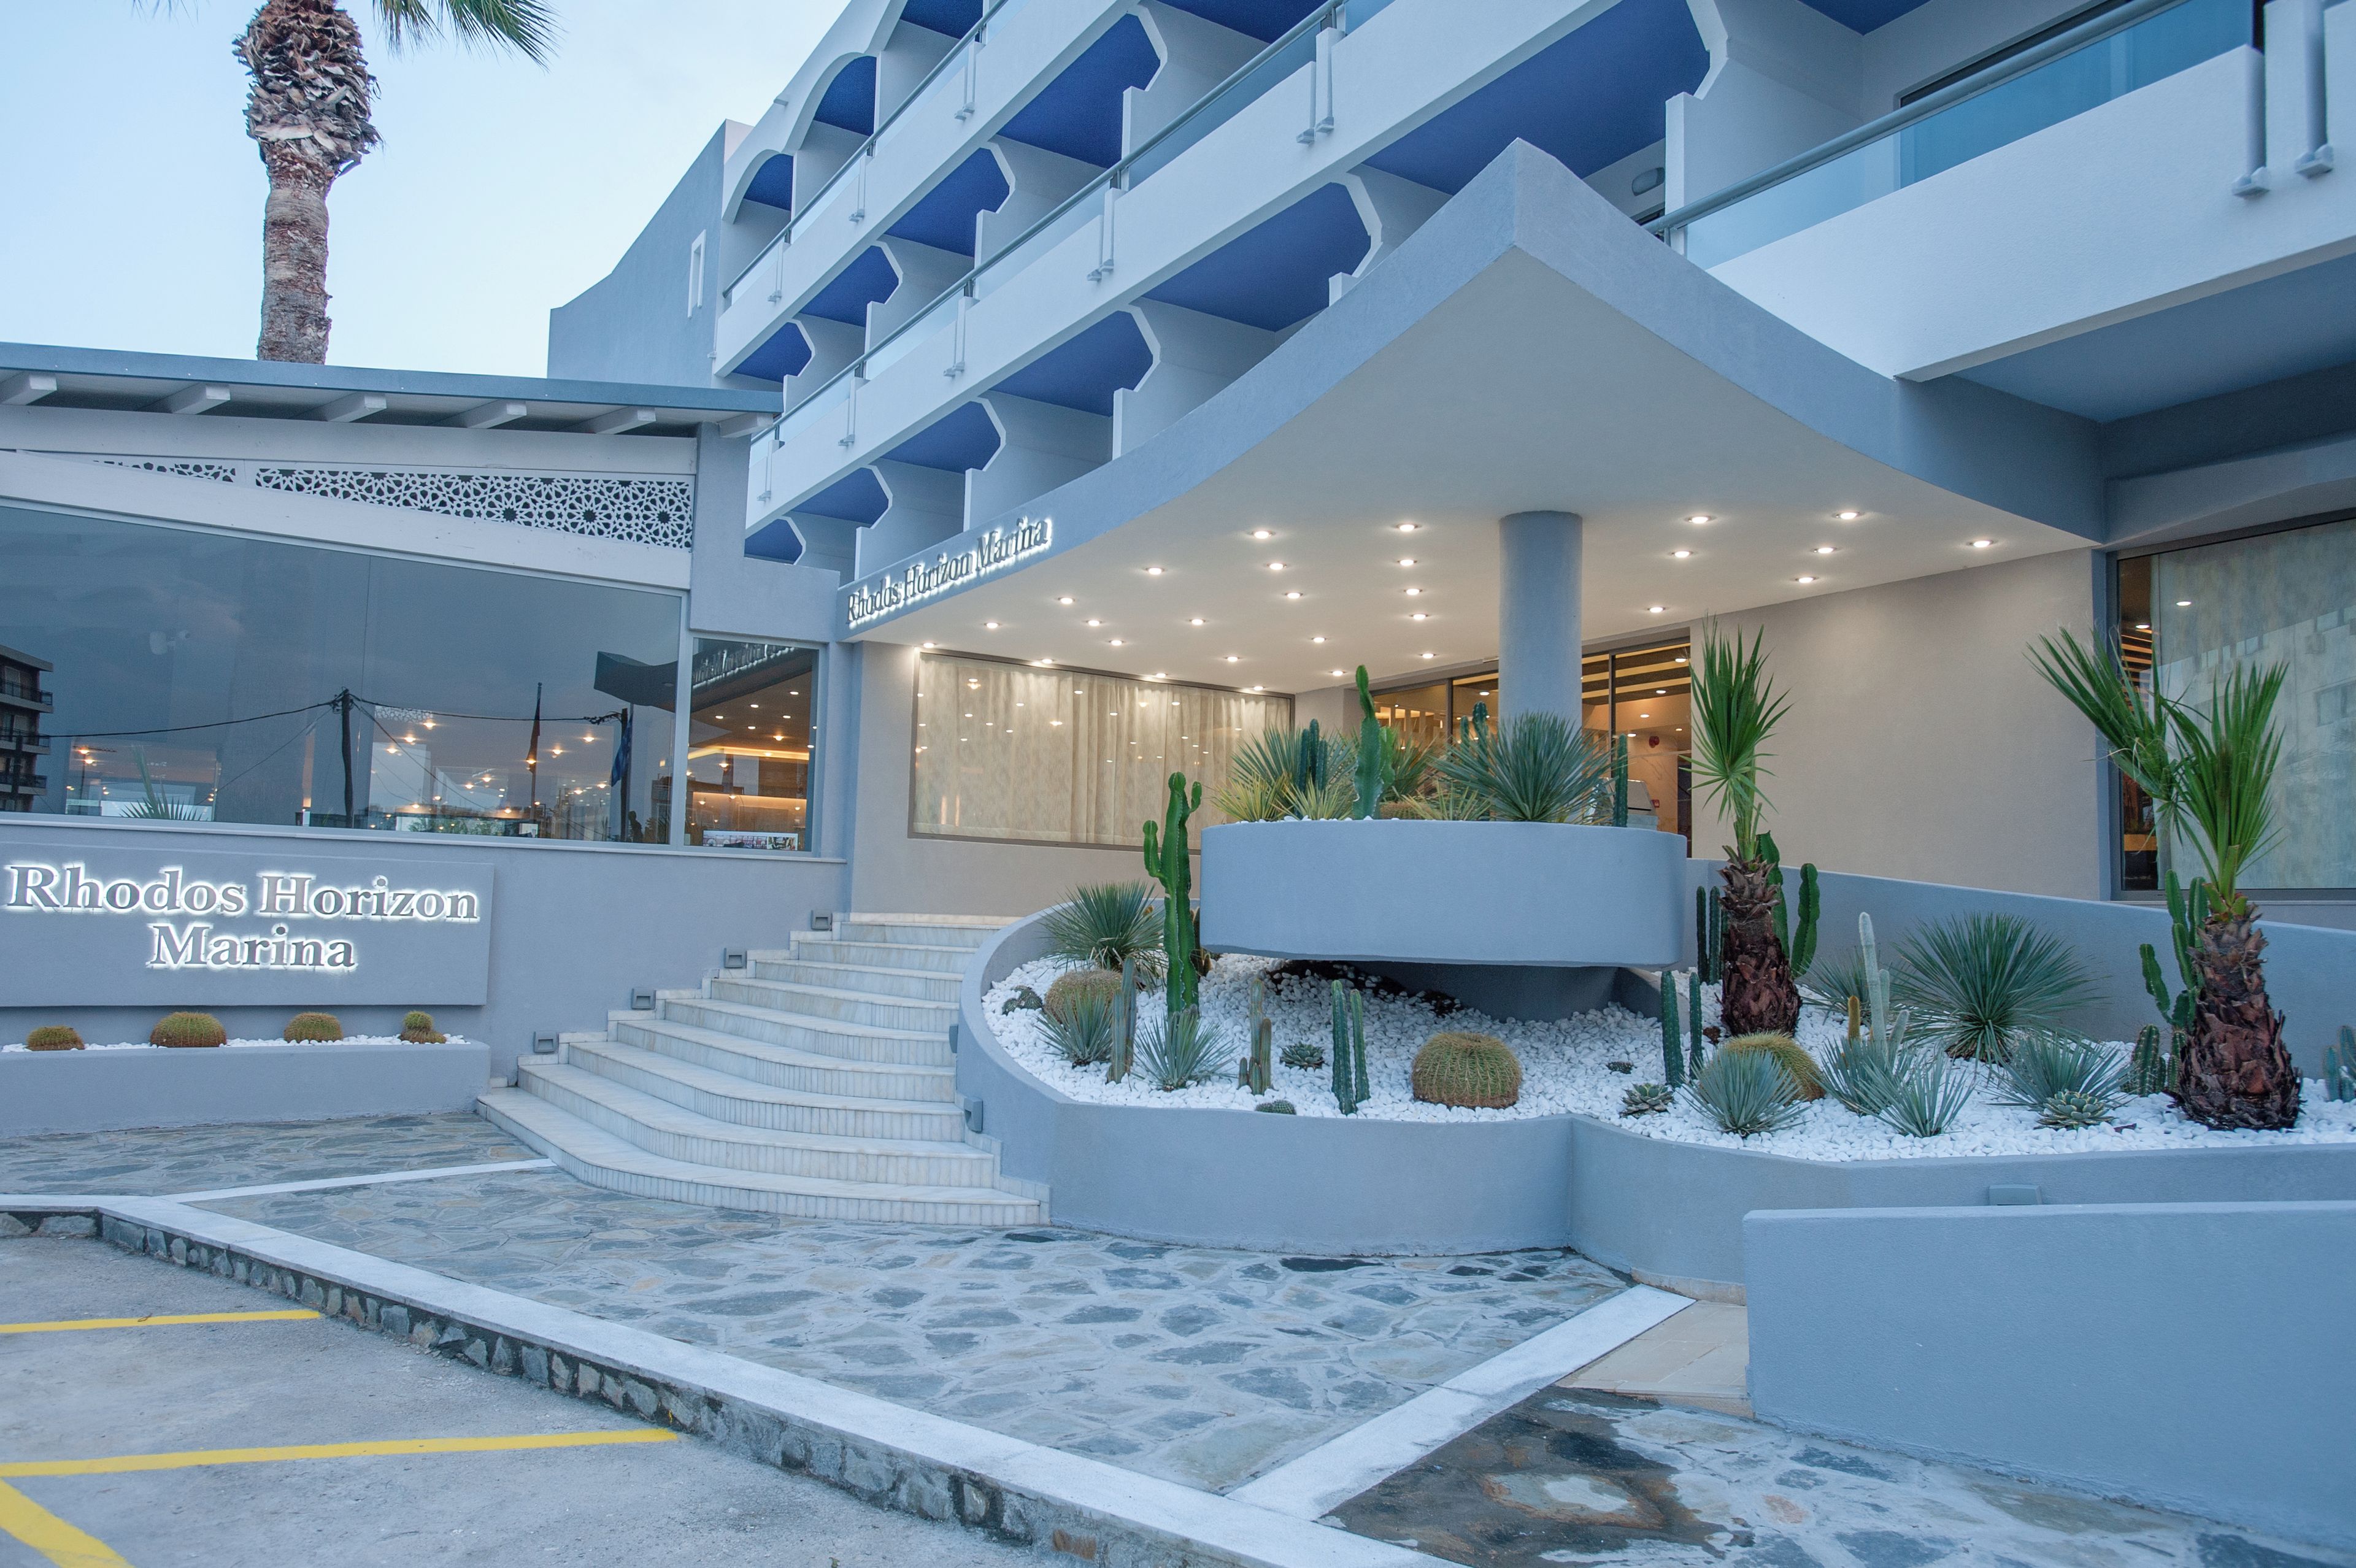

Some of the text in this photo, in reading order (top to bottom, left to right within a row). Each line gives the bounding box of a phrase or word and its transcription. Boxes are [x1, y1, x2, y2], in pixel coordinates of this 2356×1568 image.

[845, 517, 1050, 626] Rhodos Horizon Marina
[6, 863, 480, 920] Rhodos Horizon
[148, 923, 356, 970] Marina
